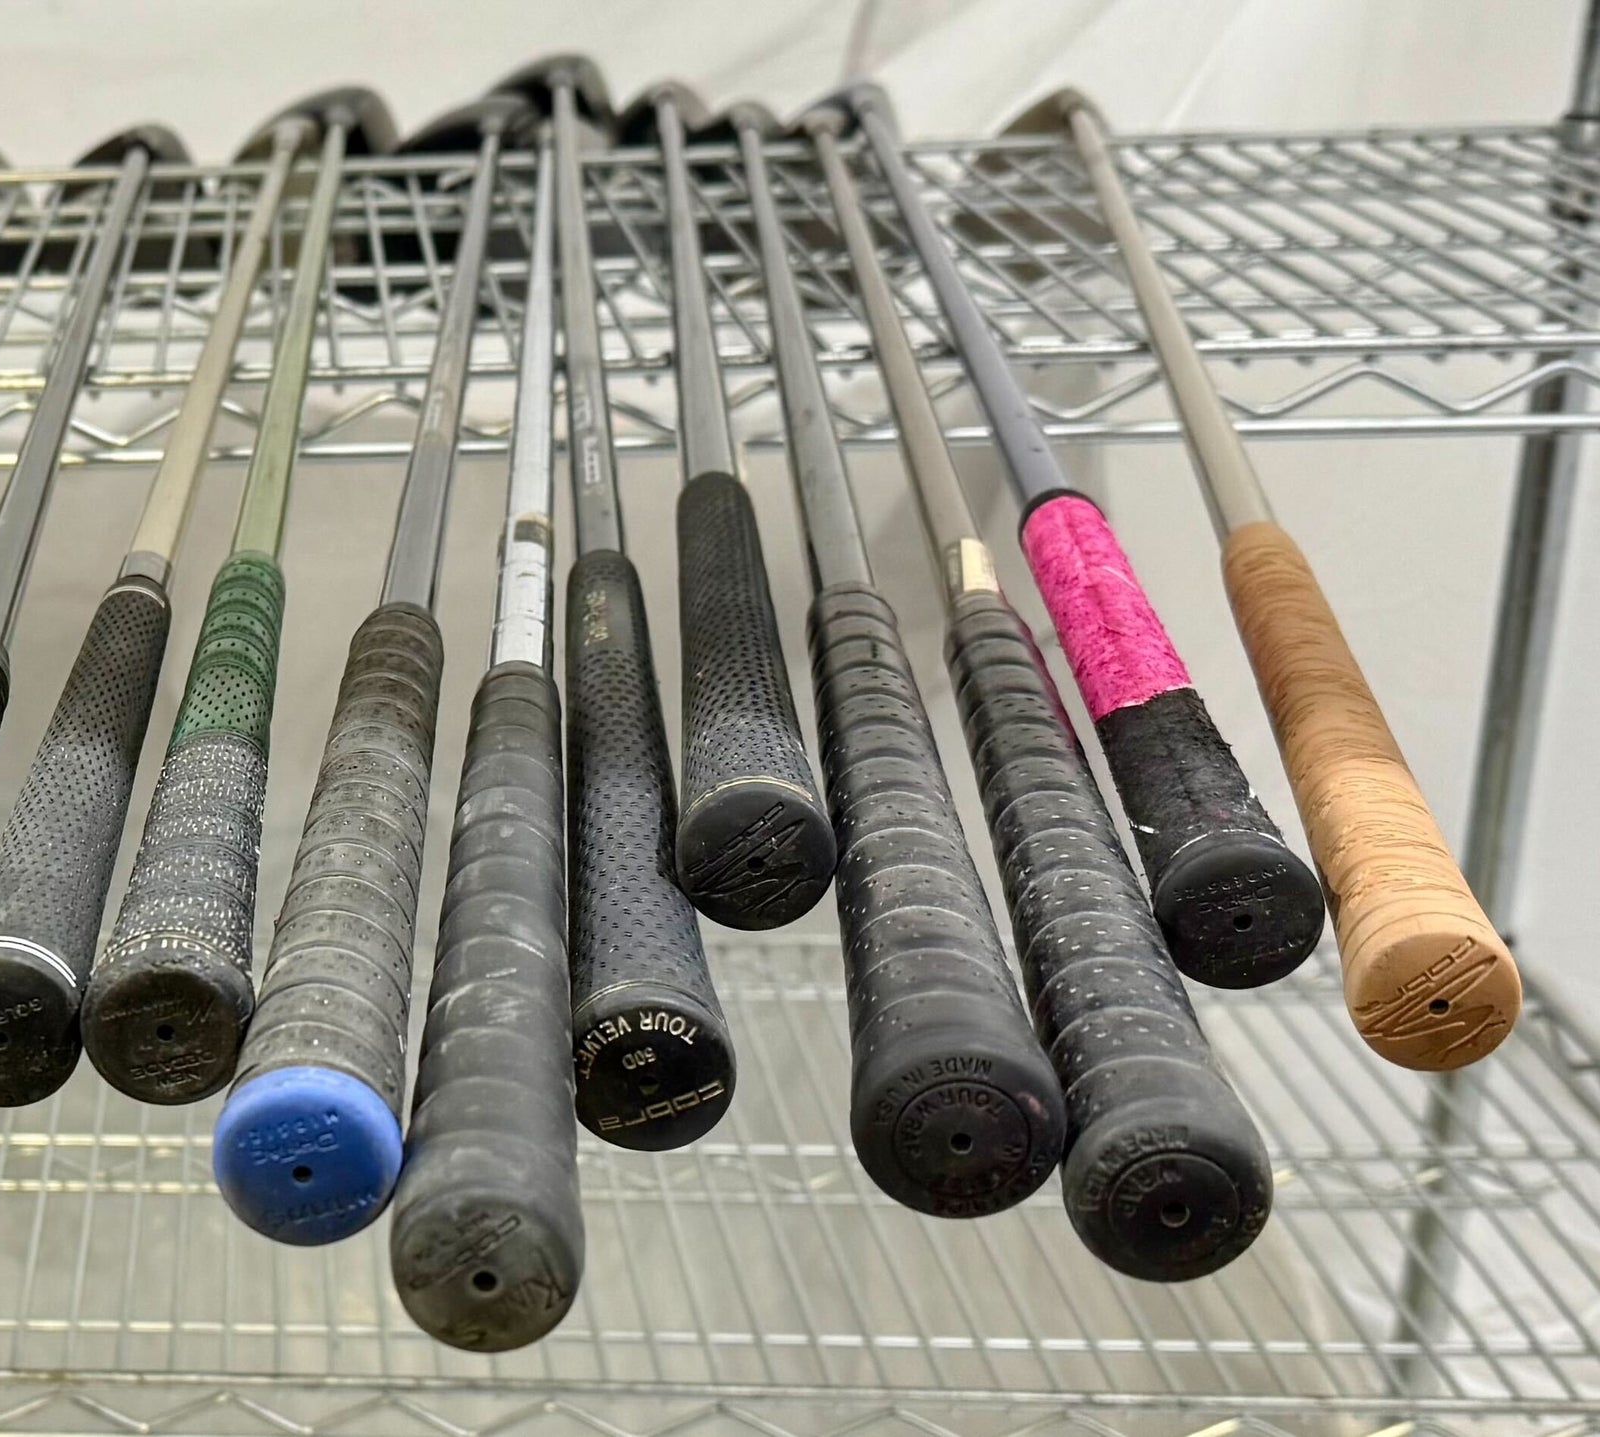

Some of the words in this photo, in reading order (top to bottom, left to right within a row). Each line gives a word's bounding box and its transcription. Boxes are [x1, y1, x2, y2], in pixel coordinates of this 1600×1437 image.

[1355, 937, 1476, 1020] cobra
[639, 1011, 699, 1045] TOUR
[575, 1014, 632, 1079] VELVET
[129, 1049, 215, 1082] DECADE
[900, 1066, 922, 1088] IN
[927, 1056, 992, 1077] MADE
[598, 1080, 726, 1131] cobra
[937, 1087, 1005, 1120] TOUR
